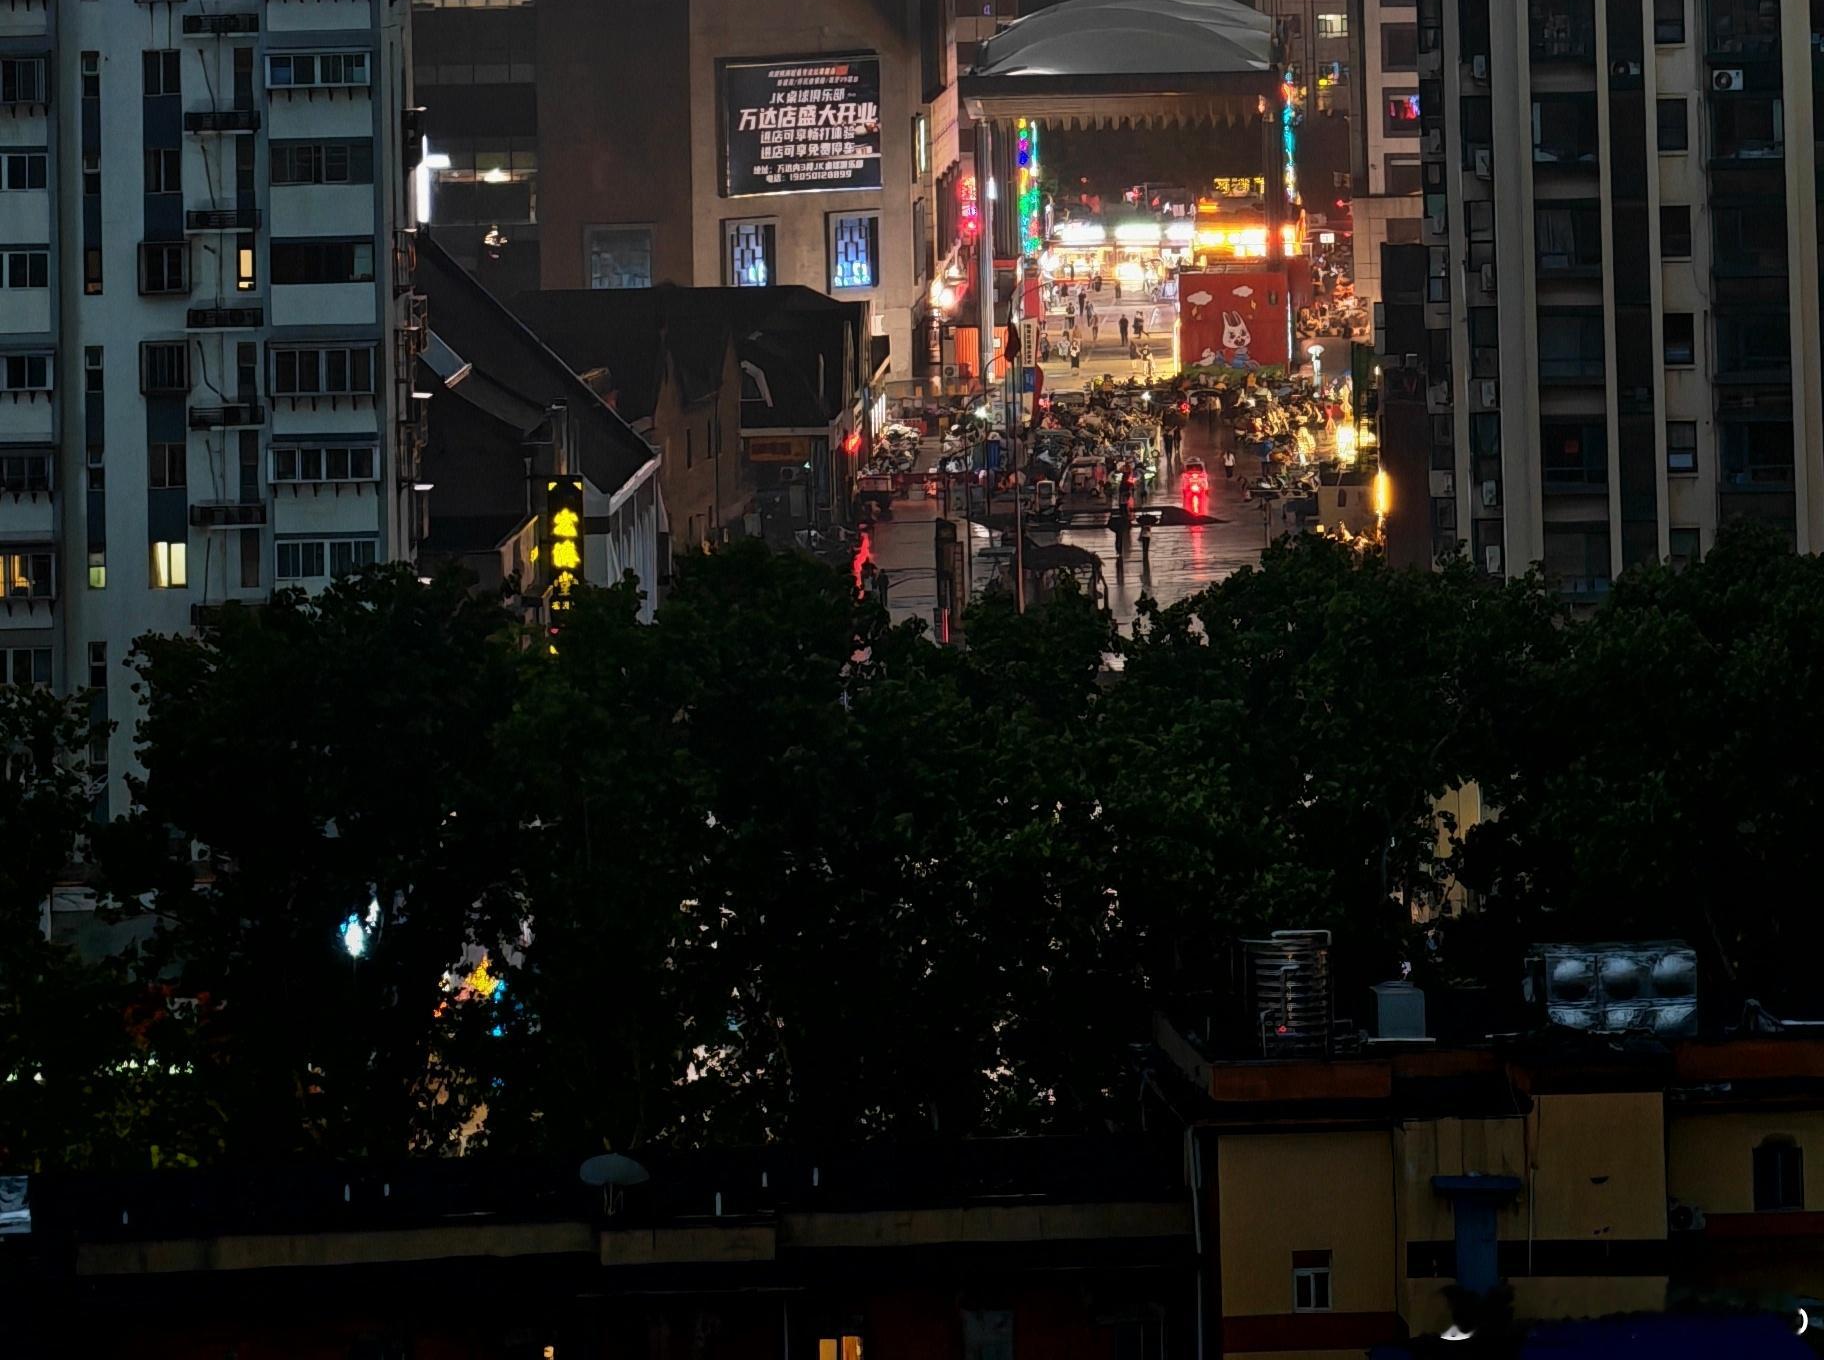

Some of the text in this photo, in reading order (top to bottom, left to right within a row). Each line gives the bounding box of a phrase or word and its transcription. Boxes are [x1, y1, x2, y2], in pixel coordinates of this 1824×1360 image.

[738, 101, 879, 131] 万达店盛大开业
[760, 141, 856, 160] 进店可享免费停车
